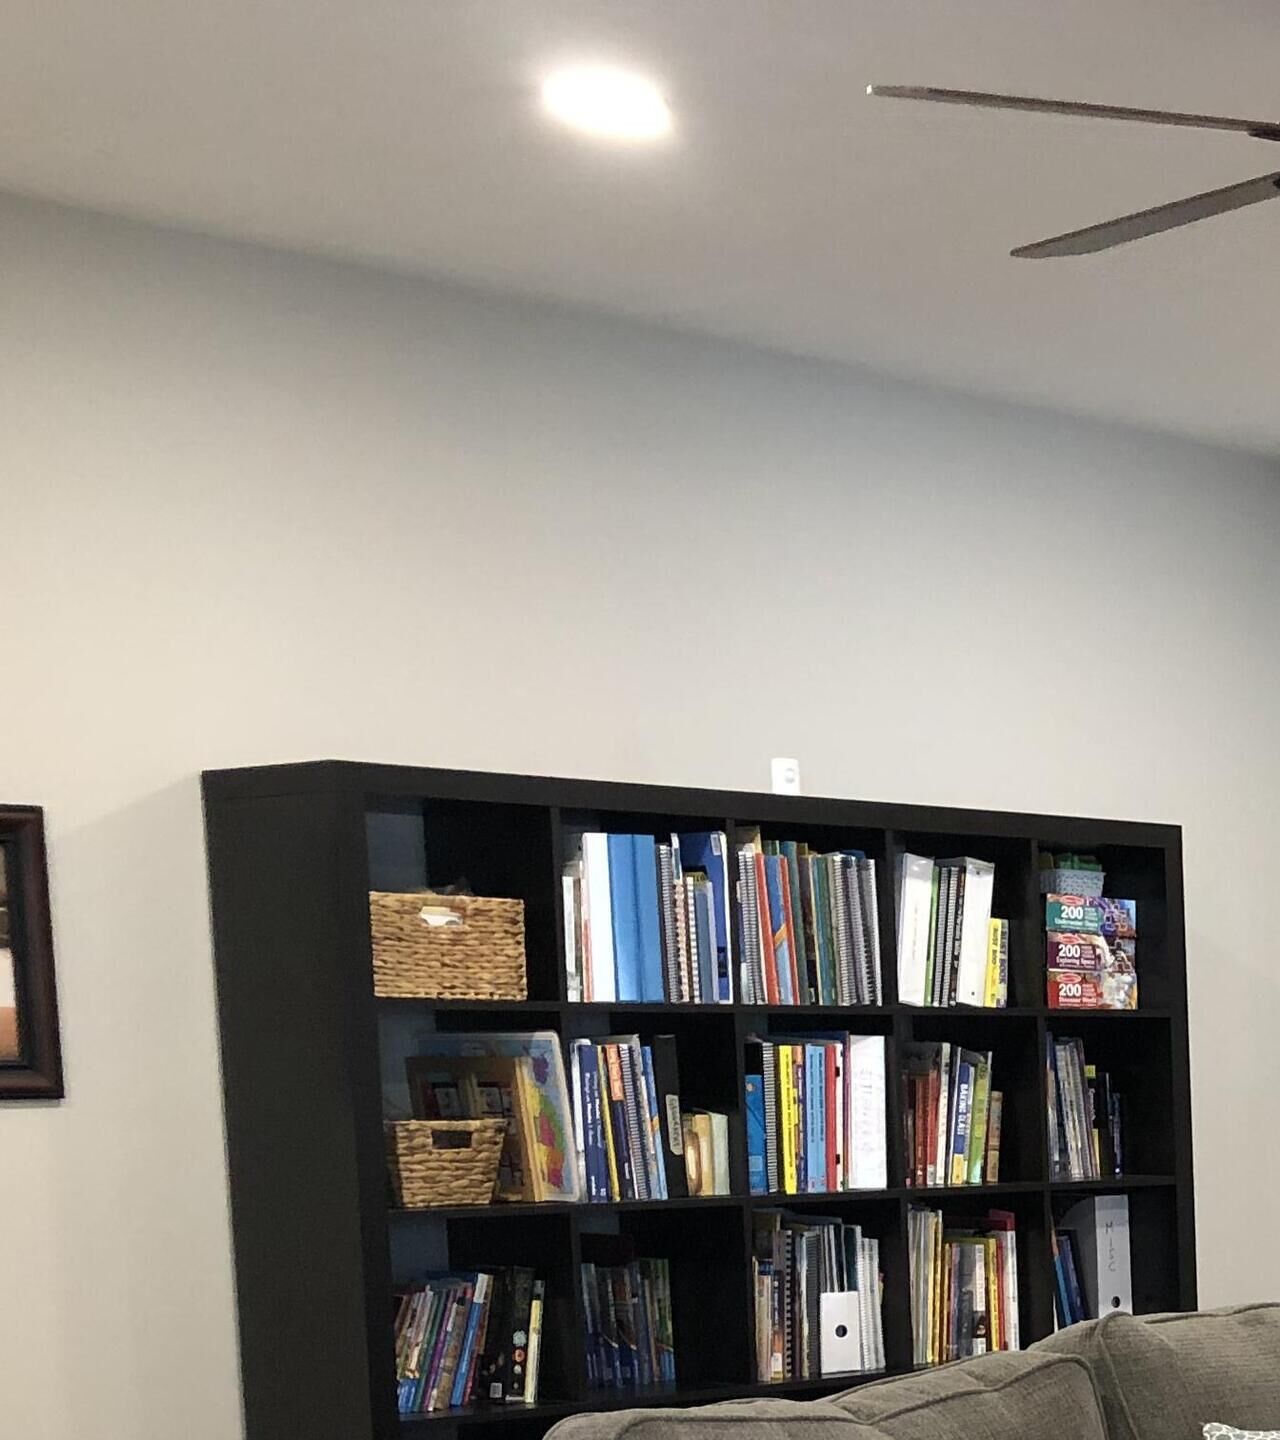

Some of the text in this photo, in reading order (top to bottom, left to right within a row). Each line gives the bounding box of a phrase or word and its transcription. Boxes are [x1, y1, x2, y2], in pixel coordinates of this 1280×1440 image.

[1061, 906, 1084, 920] 200
[1058, 944, 1080, 957] 200
[1059, 983, 1081, 996] 200
